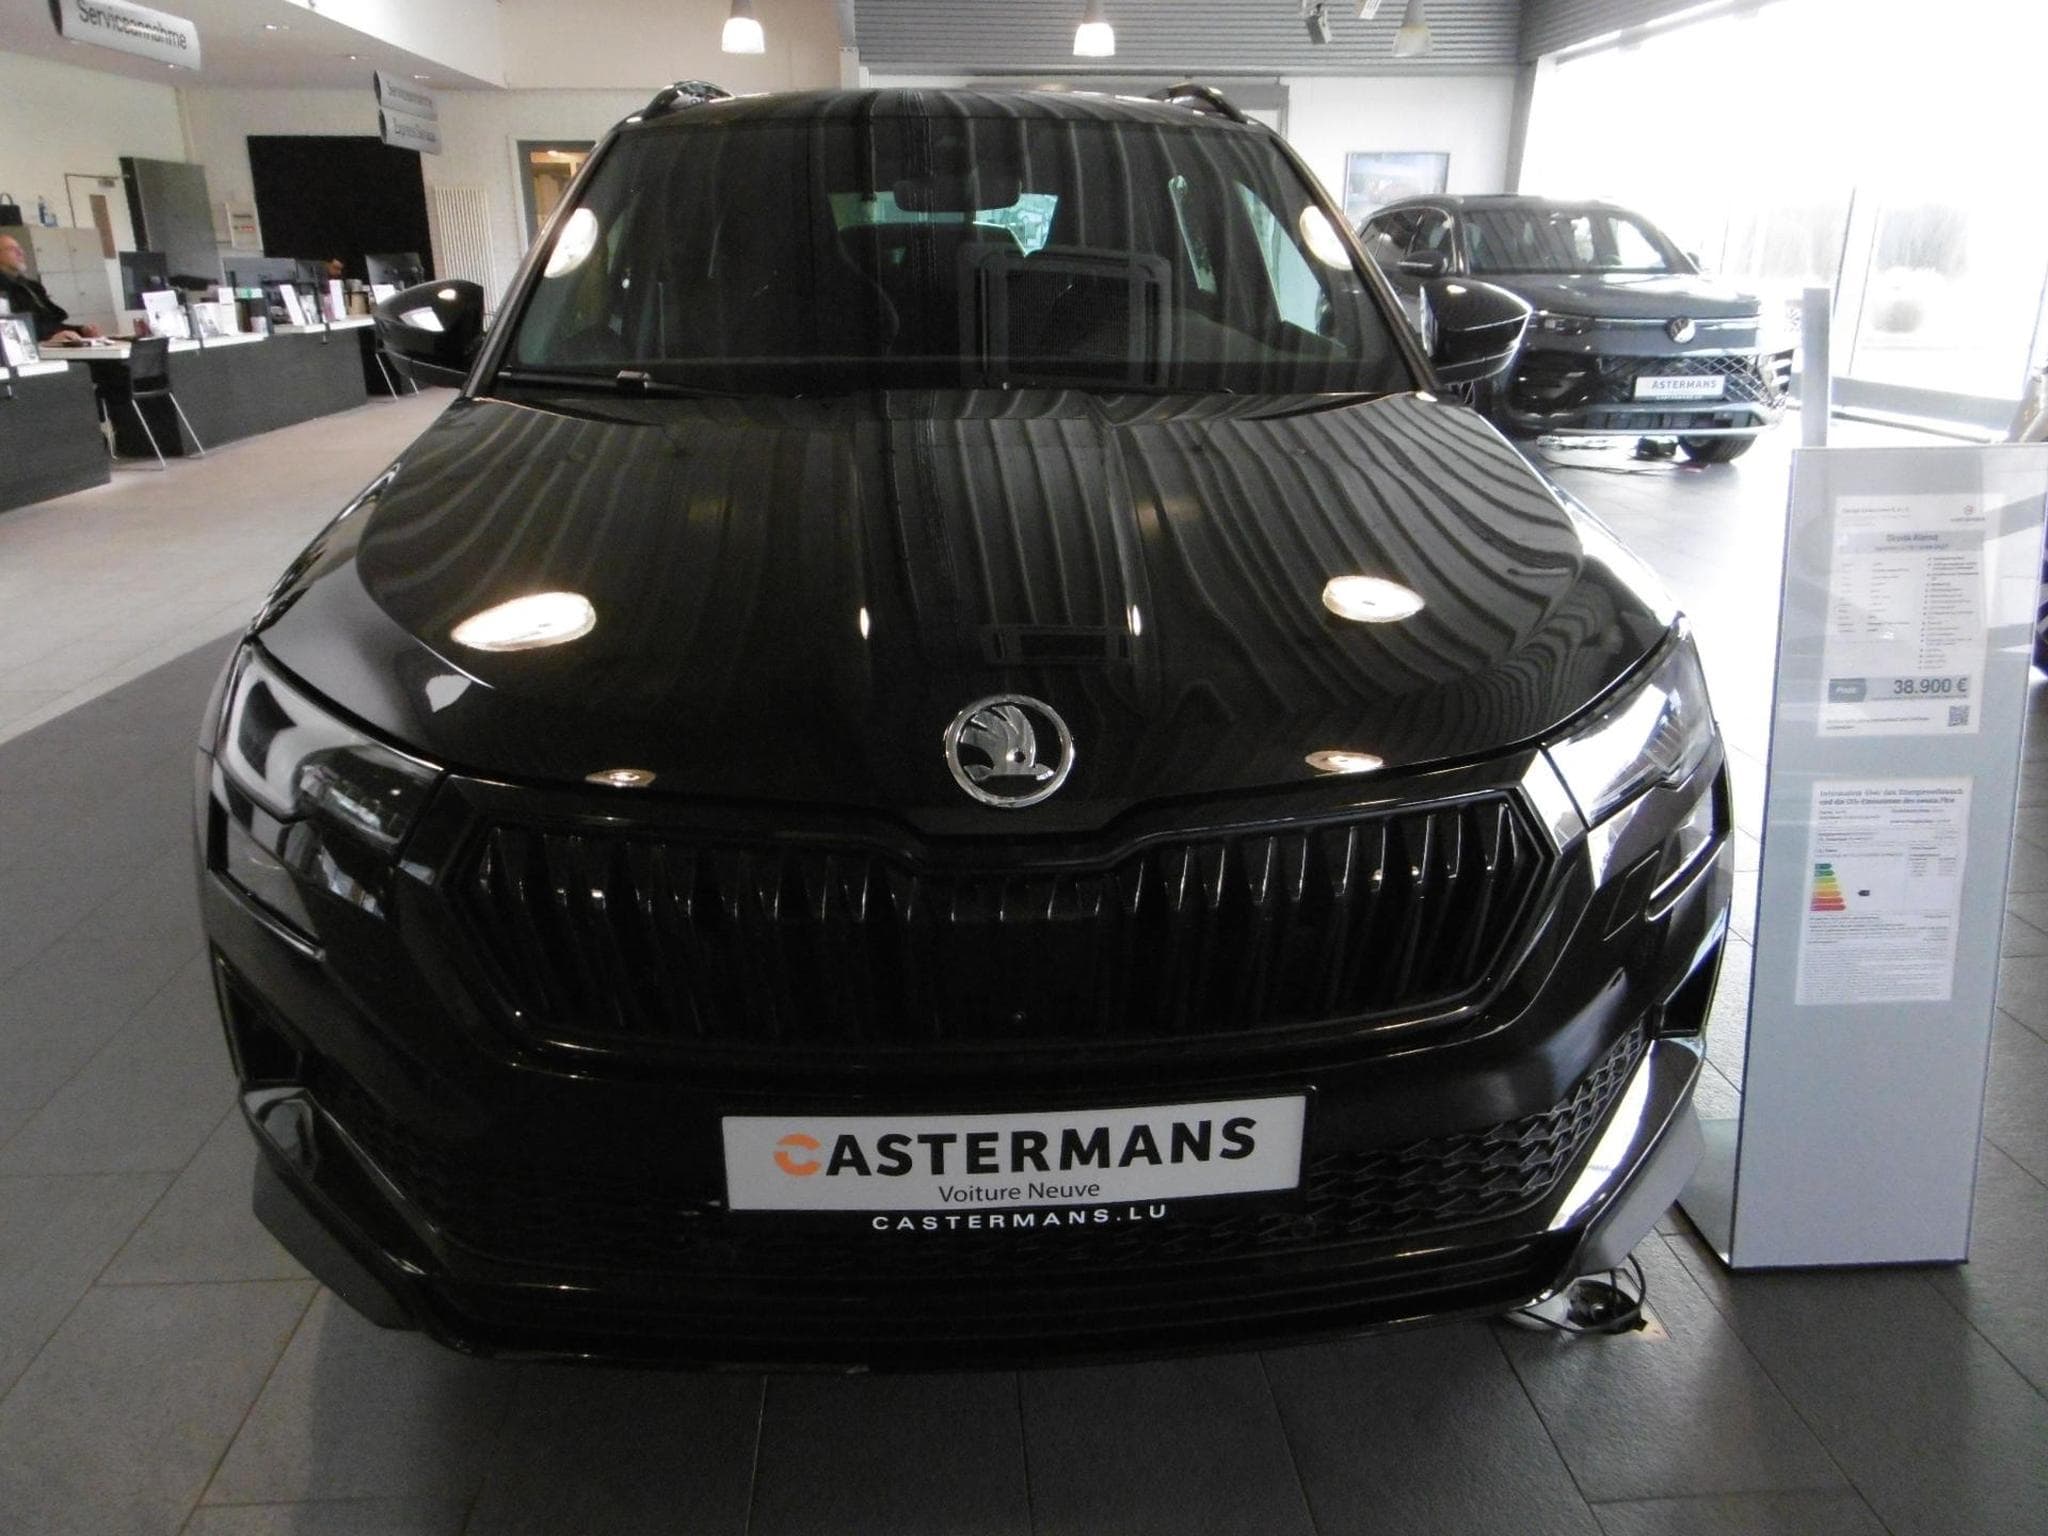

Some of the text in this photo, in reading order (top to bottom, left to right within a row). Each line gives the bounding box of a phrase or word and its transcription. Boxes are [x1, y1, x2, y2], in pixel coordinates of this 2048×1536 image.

[1893, 677, 1968, 695] 38.900 €
[772, 1116, 1257, 1177] CASTERMANS
[938, 1180, 1101, 1203] Voiture Neuve
[871, 1205, 1169, 1231] CASTERMANS.LU
